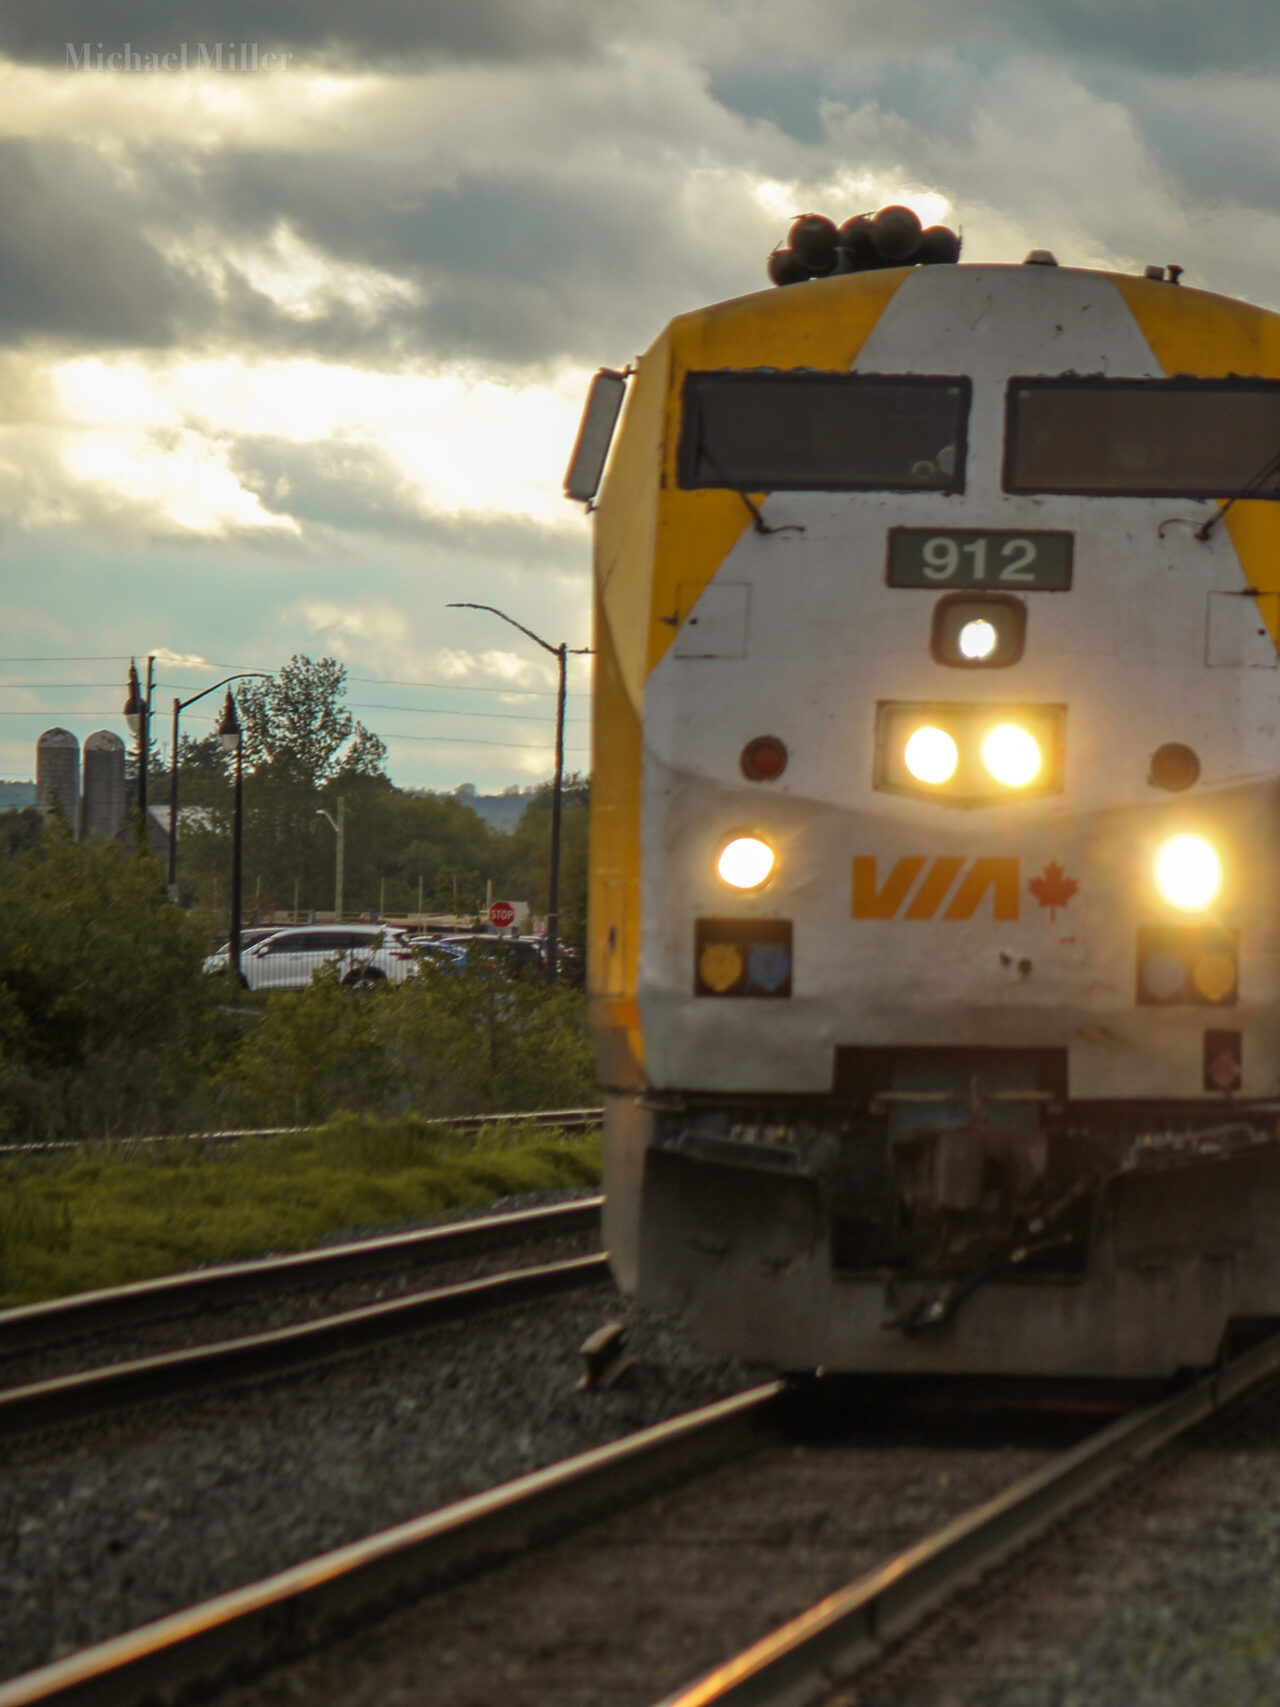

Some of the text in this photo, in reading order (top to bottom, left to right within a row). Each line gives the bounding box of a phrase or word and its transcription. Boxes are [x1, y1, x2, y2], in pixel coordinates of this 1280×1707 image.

[921, 536, 1037, 581] 912
[851, 855, 1020, 921] VIA
[490, 909, 514, 920] STOP
